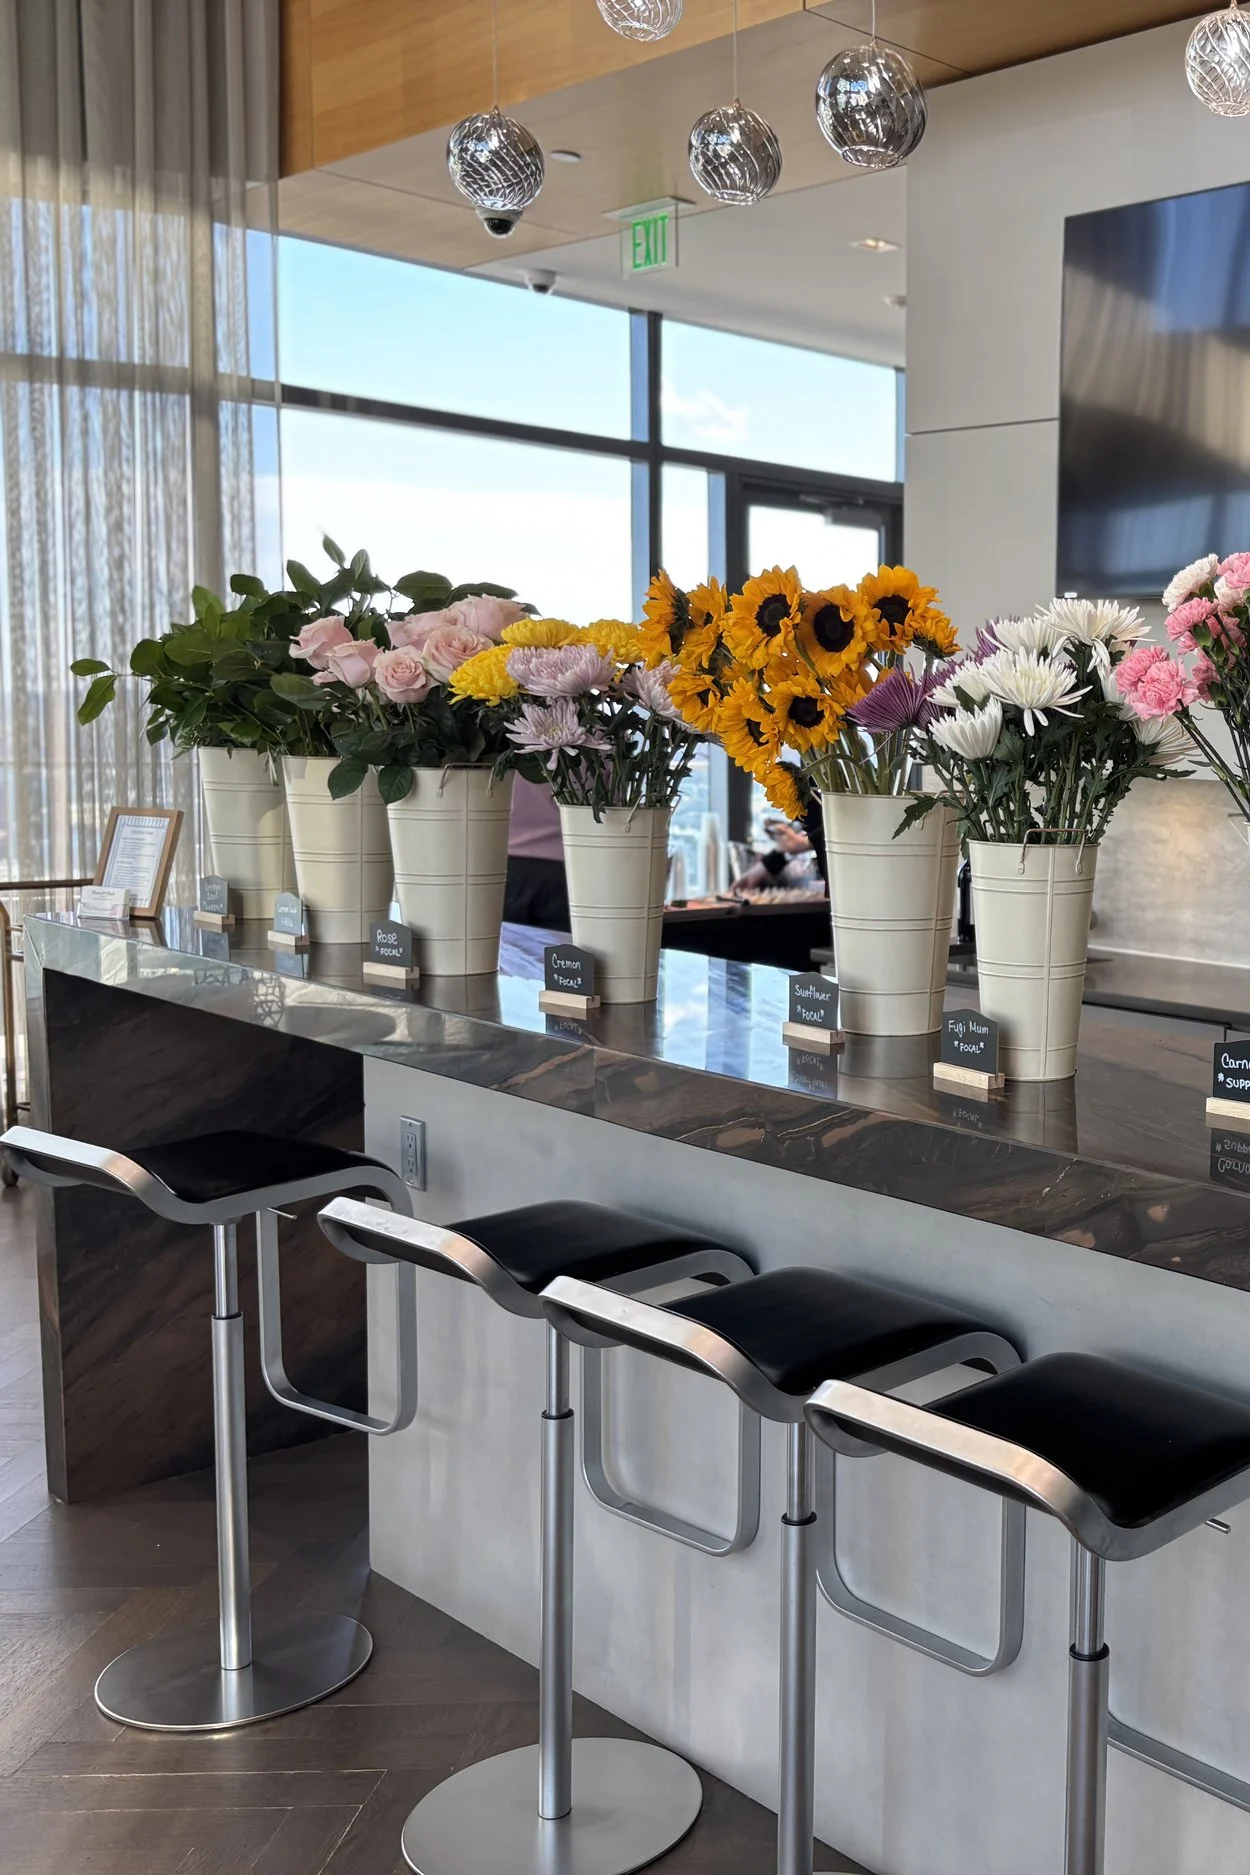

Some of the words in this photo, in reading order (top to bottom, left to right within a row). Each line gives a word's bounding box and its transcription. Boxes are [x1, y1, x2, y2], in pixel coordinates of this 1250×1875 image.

[632, 212, 669, 270] EXIT
[377, 929, 398, 945] Rose
[552, 953, 581, 971] Cremon
[795, 984, 832, 1002] Sunflower
[948, 1020, 966, 1038] Fugi
[969, 1020, 989, 1035] Mum
